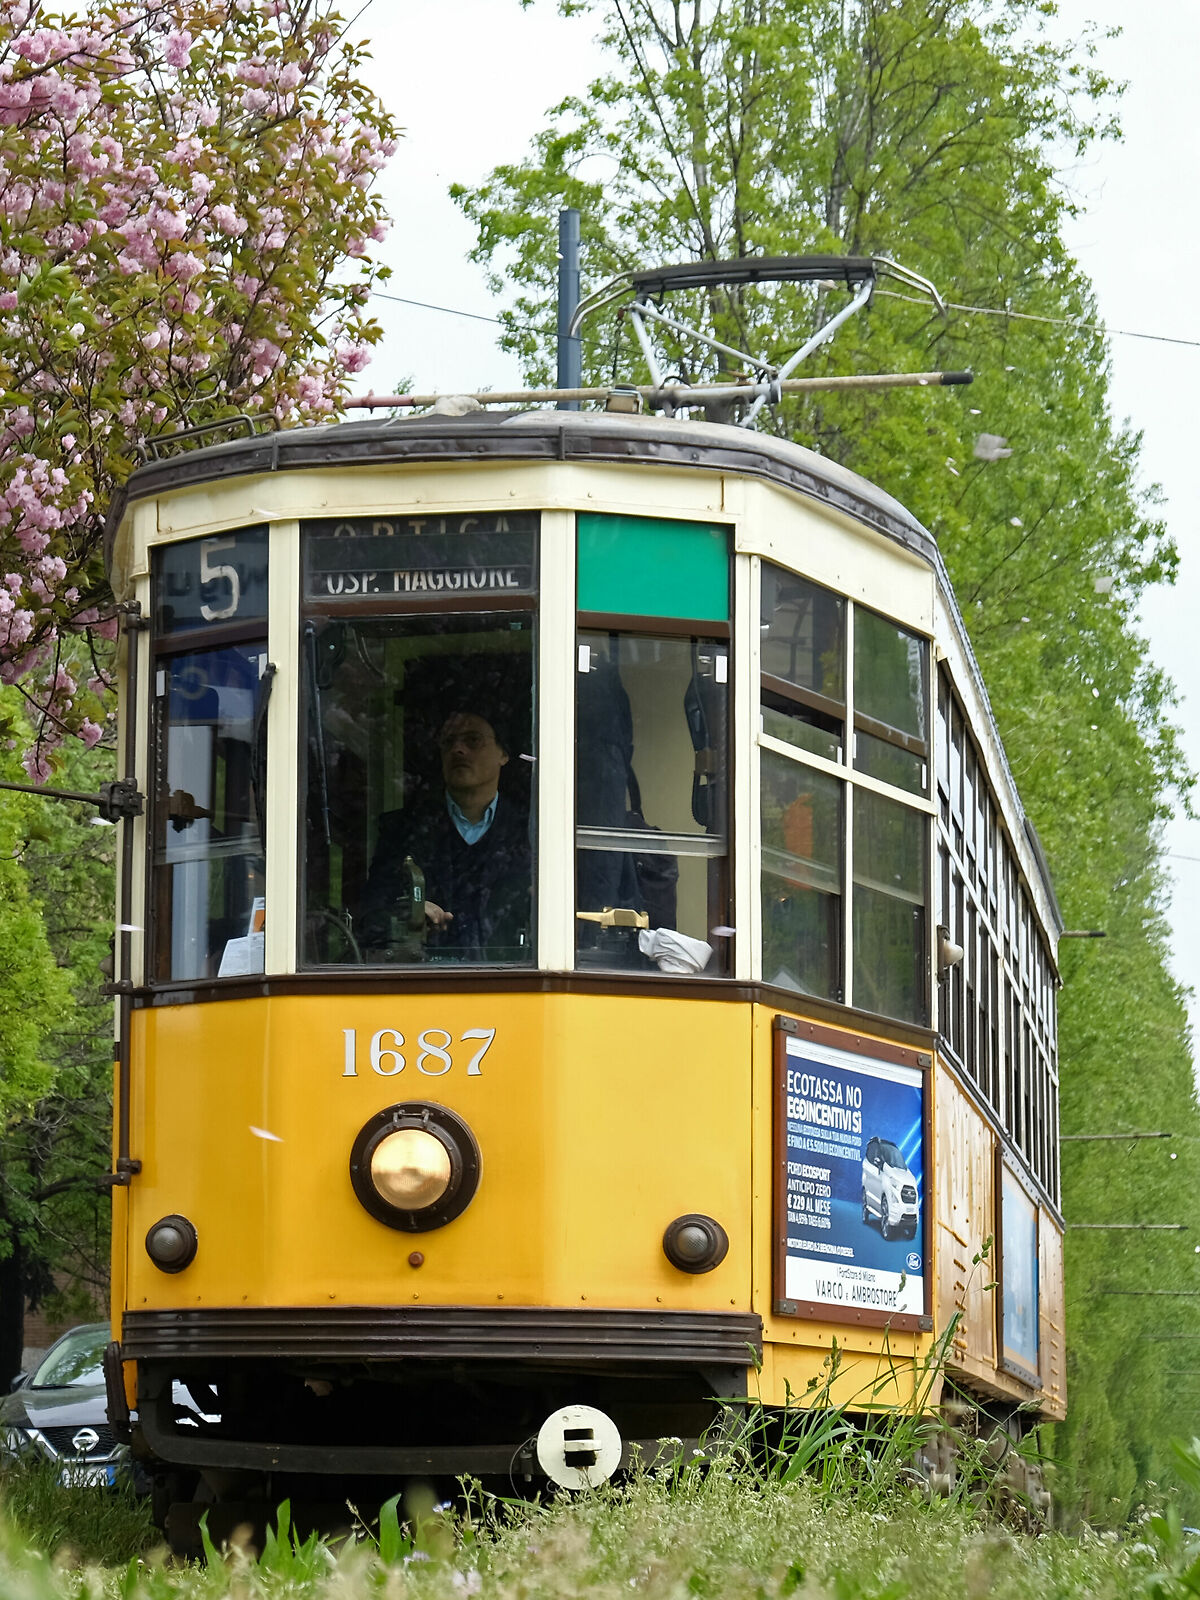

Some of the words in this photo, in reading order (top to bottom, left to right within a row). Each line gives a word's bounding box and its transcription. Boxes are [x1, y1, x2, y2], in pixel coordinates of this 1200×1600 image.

[200, 536, 240, 622] 5
[341, 1028, 497, 1077] 1687
[787, 1069, 843, 1105] ECOTASSA
[846, 1084, 862, 1109] NO
[787, 1095, 852, 1132] ECOINCENTIVI
[787, 1161, 802, 1176] FORD
[802, 1164, 831, 1181] ECOSPORT
[787, 1178, 815, 1195] ANTICIPO
[815, 1183, 831, 1198] ZERO
[787, 1193, 793, 1208] €
[793, 1194, 805, 1210] 229
[806, 1197, 814, 1212] AL
[815, 1199, 831, 1216] MESE
[815, 1280, 843, 1300] VARCO
[852, 1285, 897, 1307] AMBROSTORE
